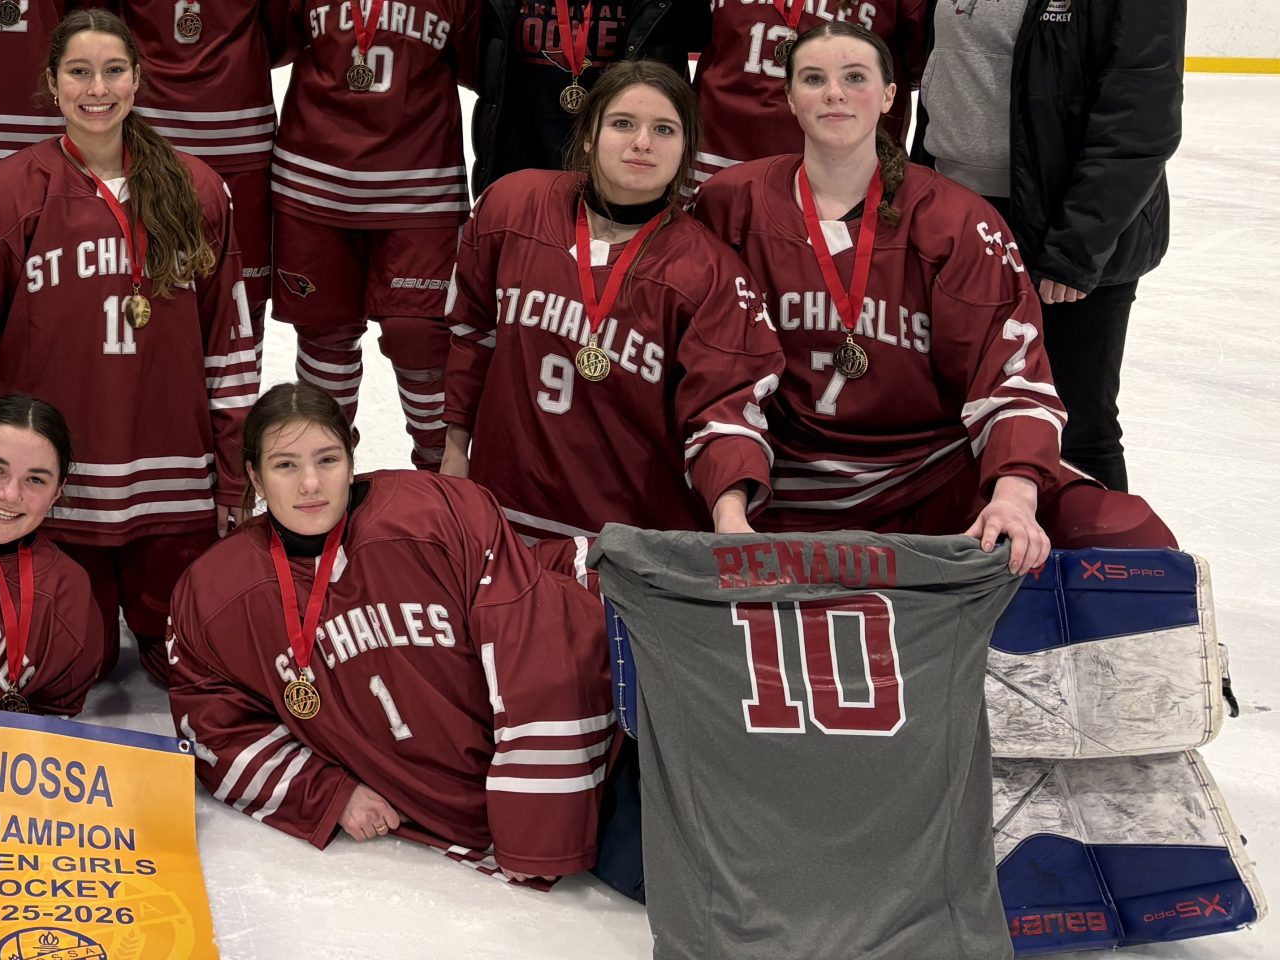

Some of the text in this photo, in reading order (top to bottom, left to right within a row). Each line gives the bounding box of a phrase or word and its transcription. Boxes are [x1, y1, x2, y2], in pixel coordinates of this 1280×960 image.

[310, 5, 331, 39] ST
[1039, 12, 1072, 23] OCKEY
[26, 248, 63, 293] ST
[103, 295, 137, 355] 11
[496, 288, 521, 324] ST
[1003, 319, 1039, 376] 7
[537, 352, 575, 415] 9
[811, 350, 850, 416] 7
[713, 541, 897, 589] RENAUD
[316, 602, 456, 670] CHARLES
[731, 592, 907, 737] 10
[369, 675, 413, 742] 1
[52, 855, 157, 876] GIRLS
